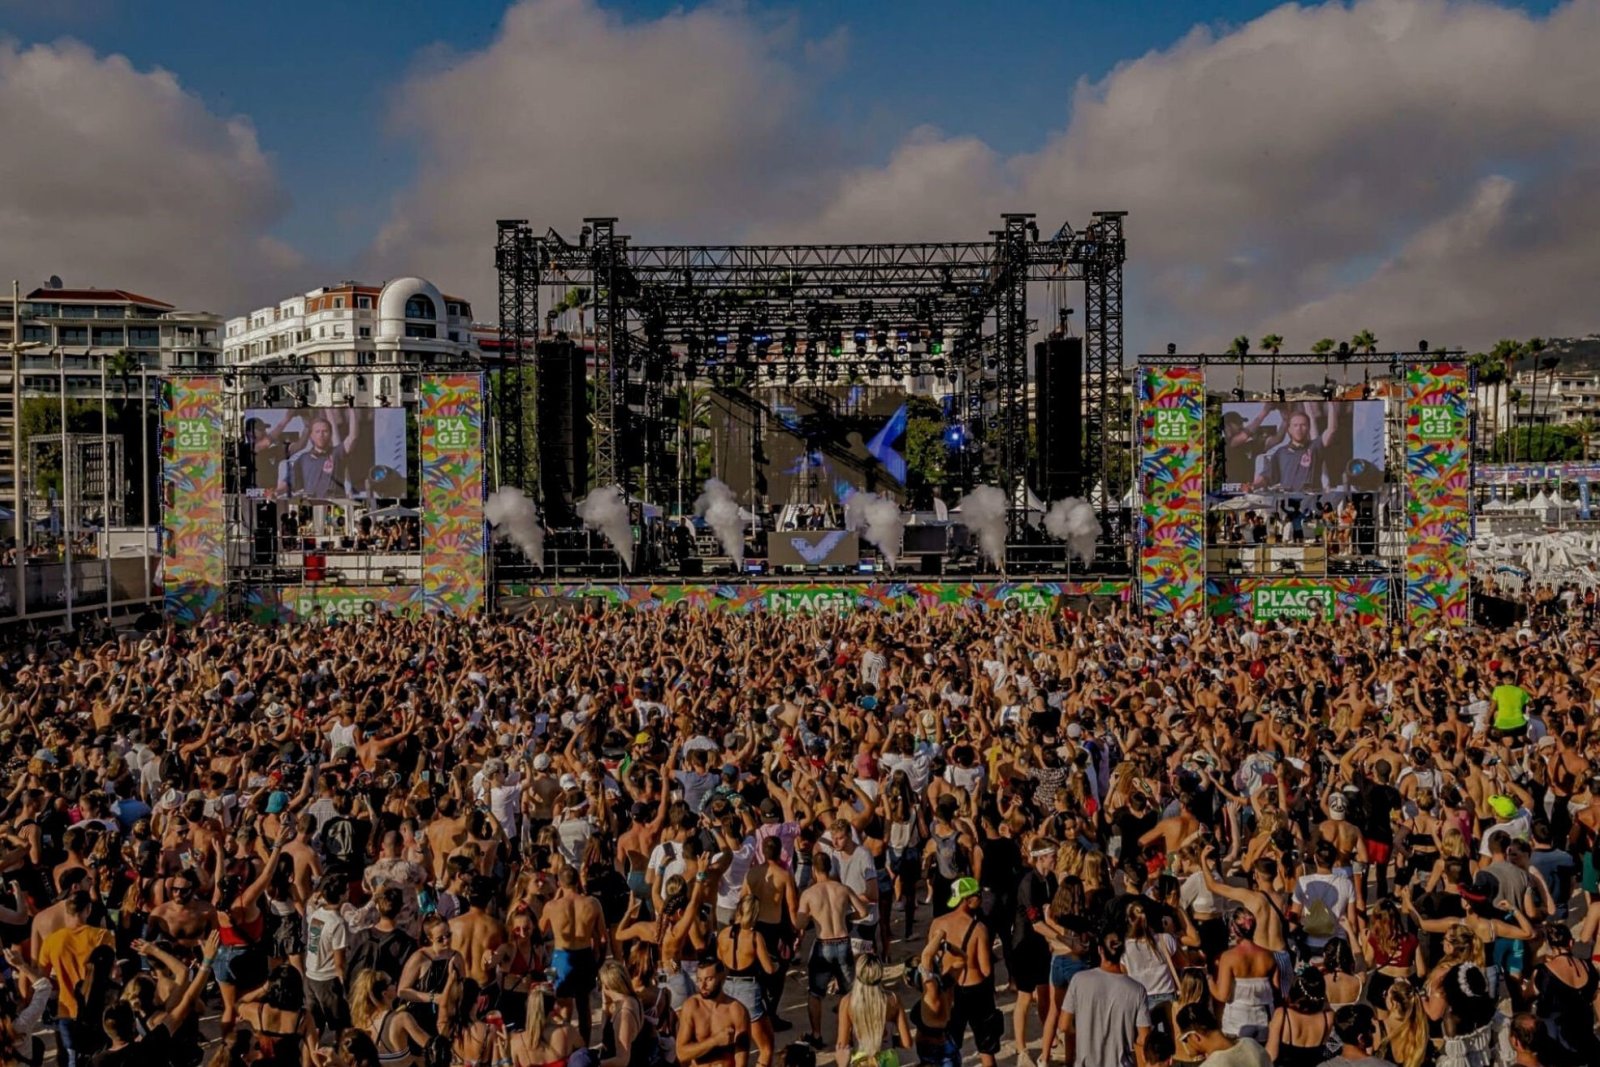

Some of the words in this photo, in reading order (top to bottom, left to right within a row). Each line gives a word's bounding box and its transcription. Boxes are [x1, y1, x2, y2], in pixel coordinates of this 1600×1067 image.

[1158, 410, 1187, 423] PLA
[1422, 408, 1451, 420] PLA
[179, 421, 208, 433] PLA
[437, 419, 466, 431] PLA
[1158, 424, 1187, 436] GES
[1423, 421, 1451, 433] GES
[180, 434, 207, 446] GES
[438, 432, 466, 444] GES
